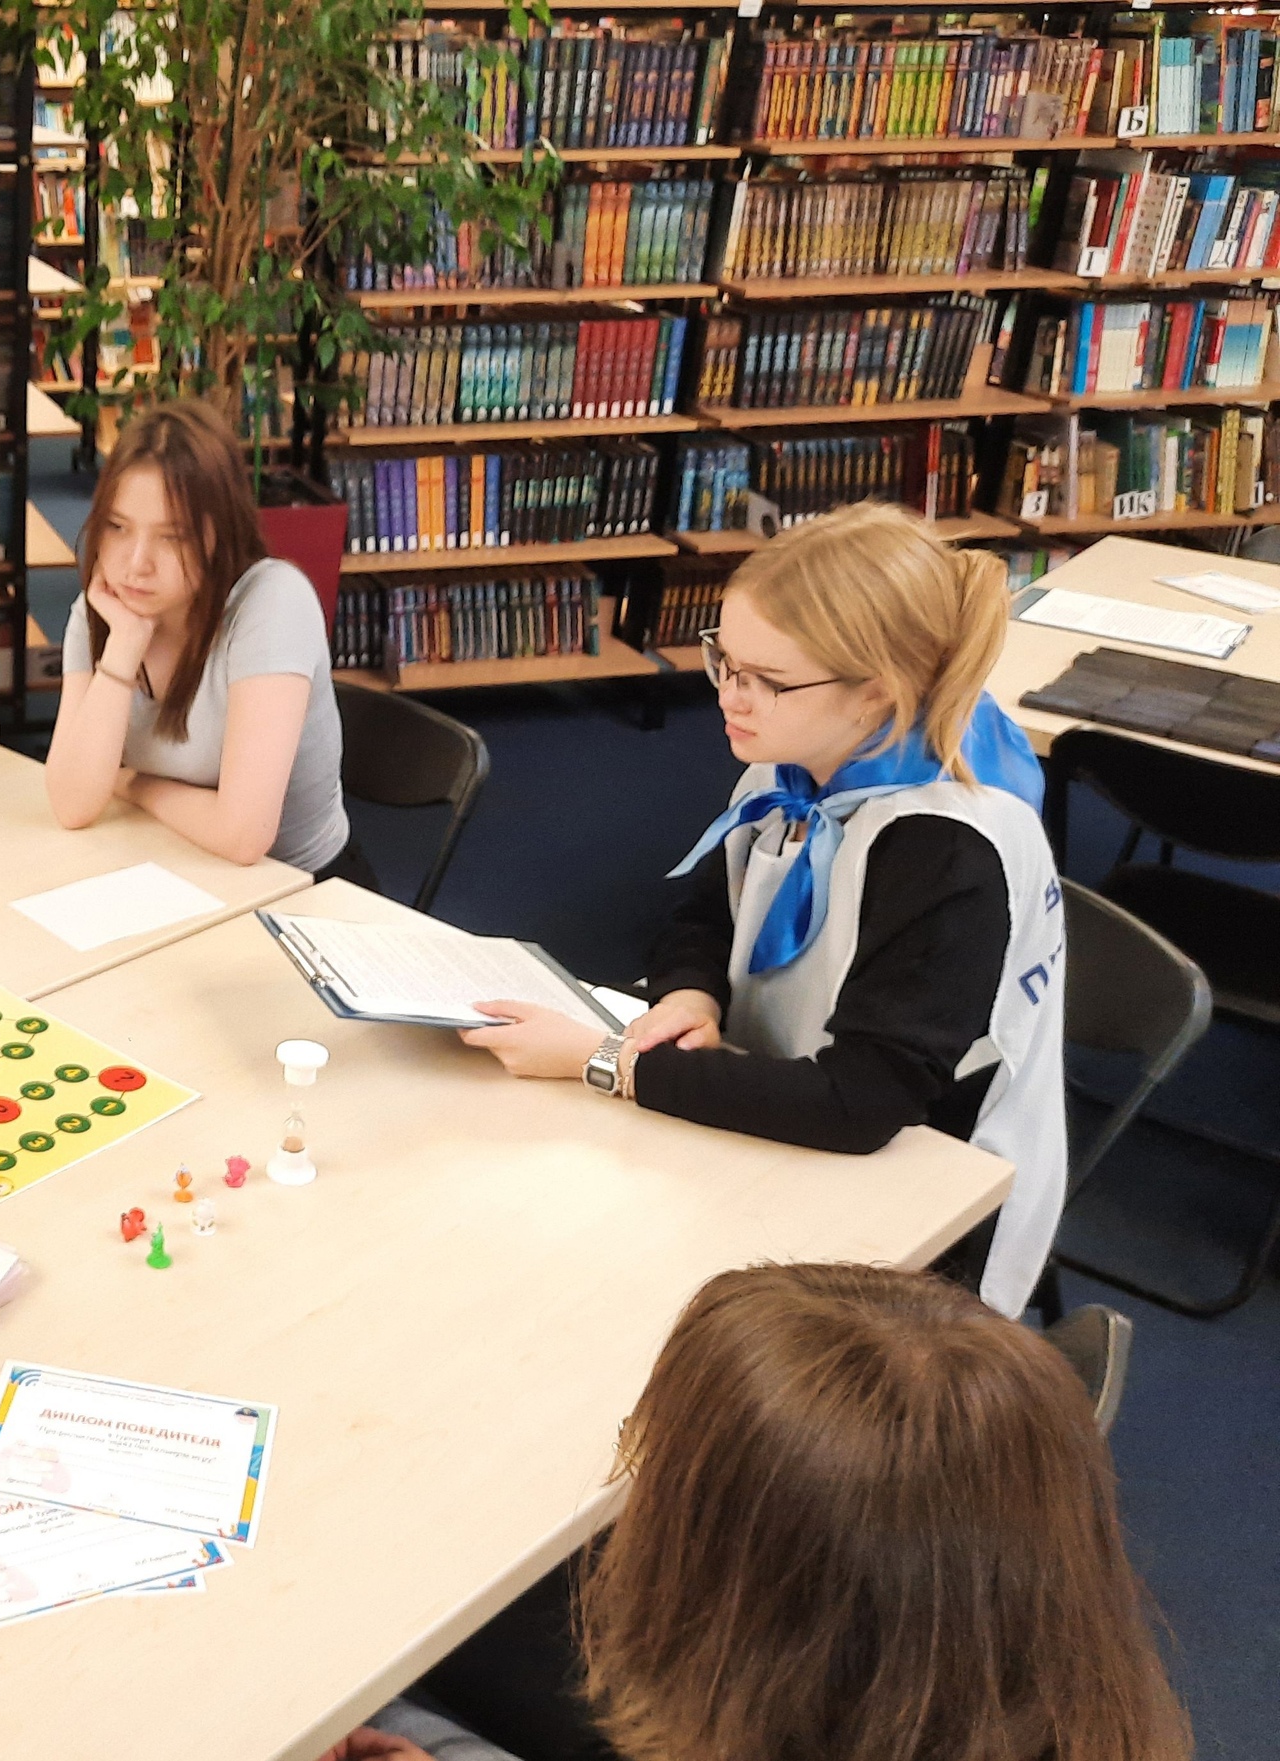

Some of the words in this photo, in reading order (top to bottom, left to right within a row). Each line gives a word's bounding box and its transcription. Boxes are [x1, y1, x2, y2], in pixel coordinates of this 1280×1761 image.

[1126, 108, 1145, 132] Б
[38, 1408, 112, 1428] ДИПЛОМ
[115, 1421, 221, 1448] ПОБЕДИТЕЛЯ
